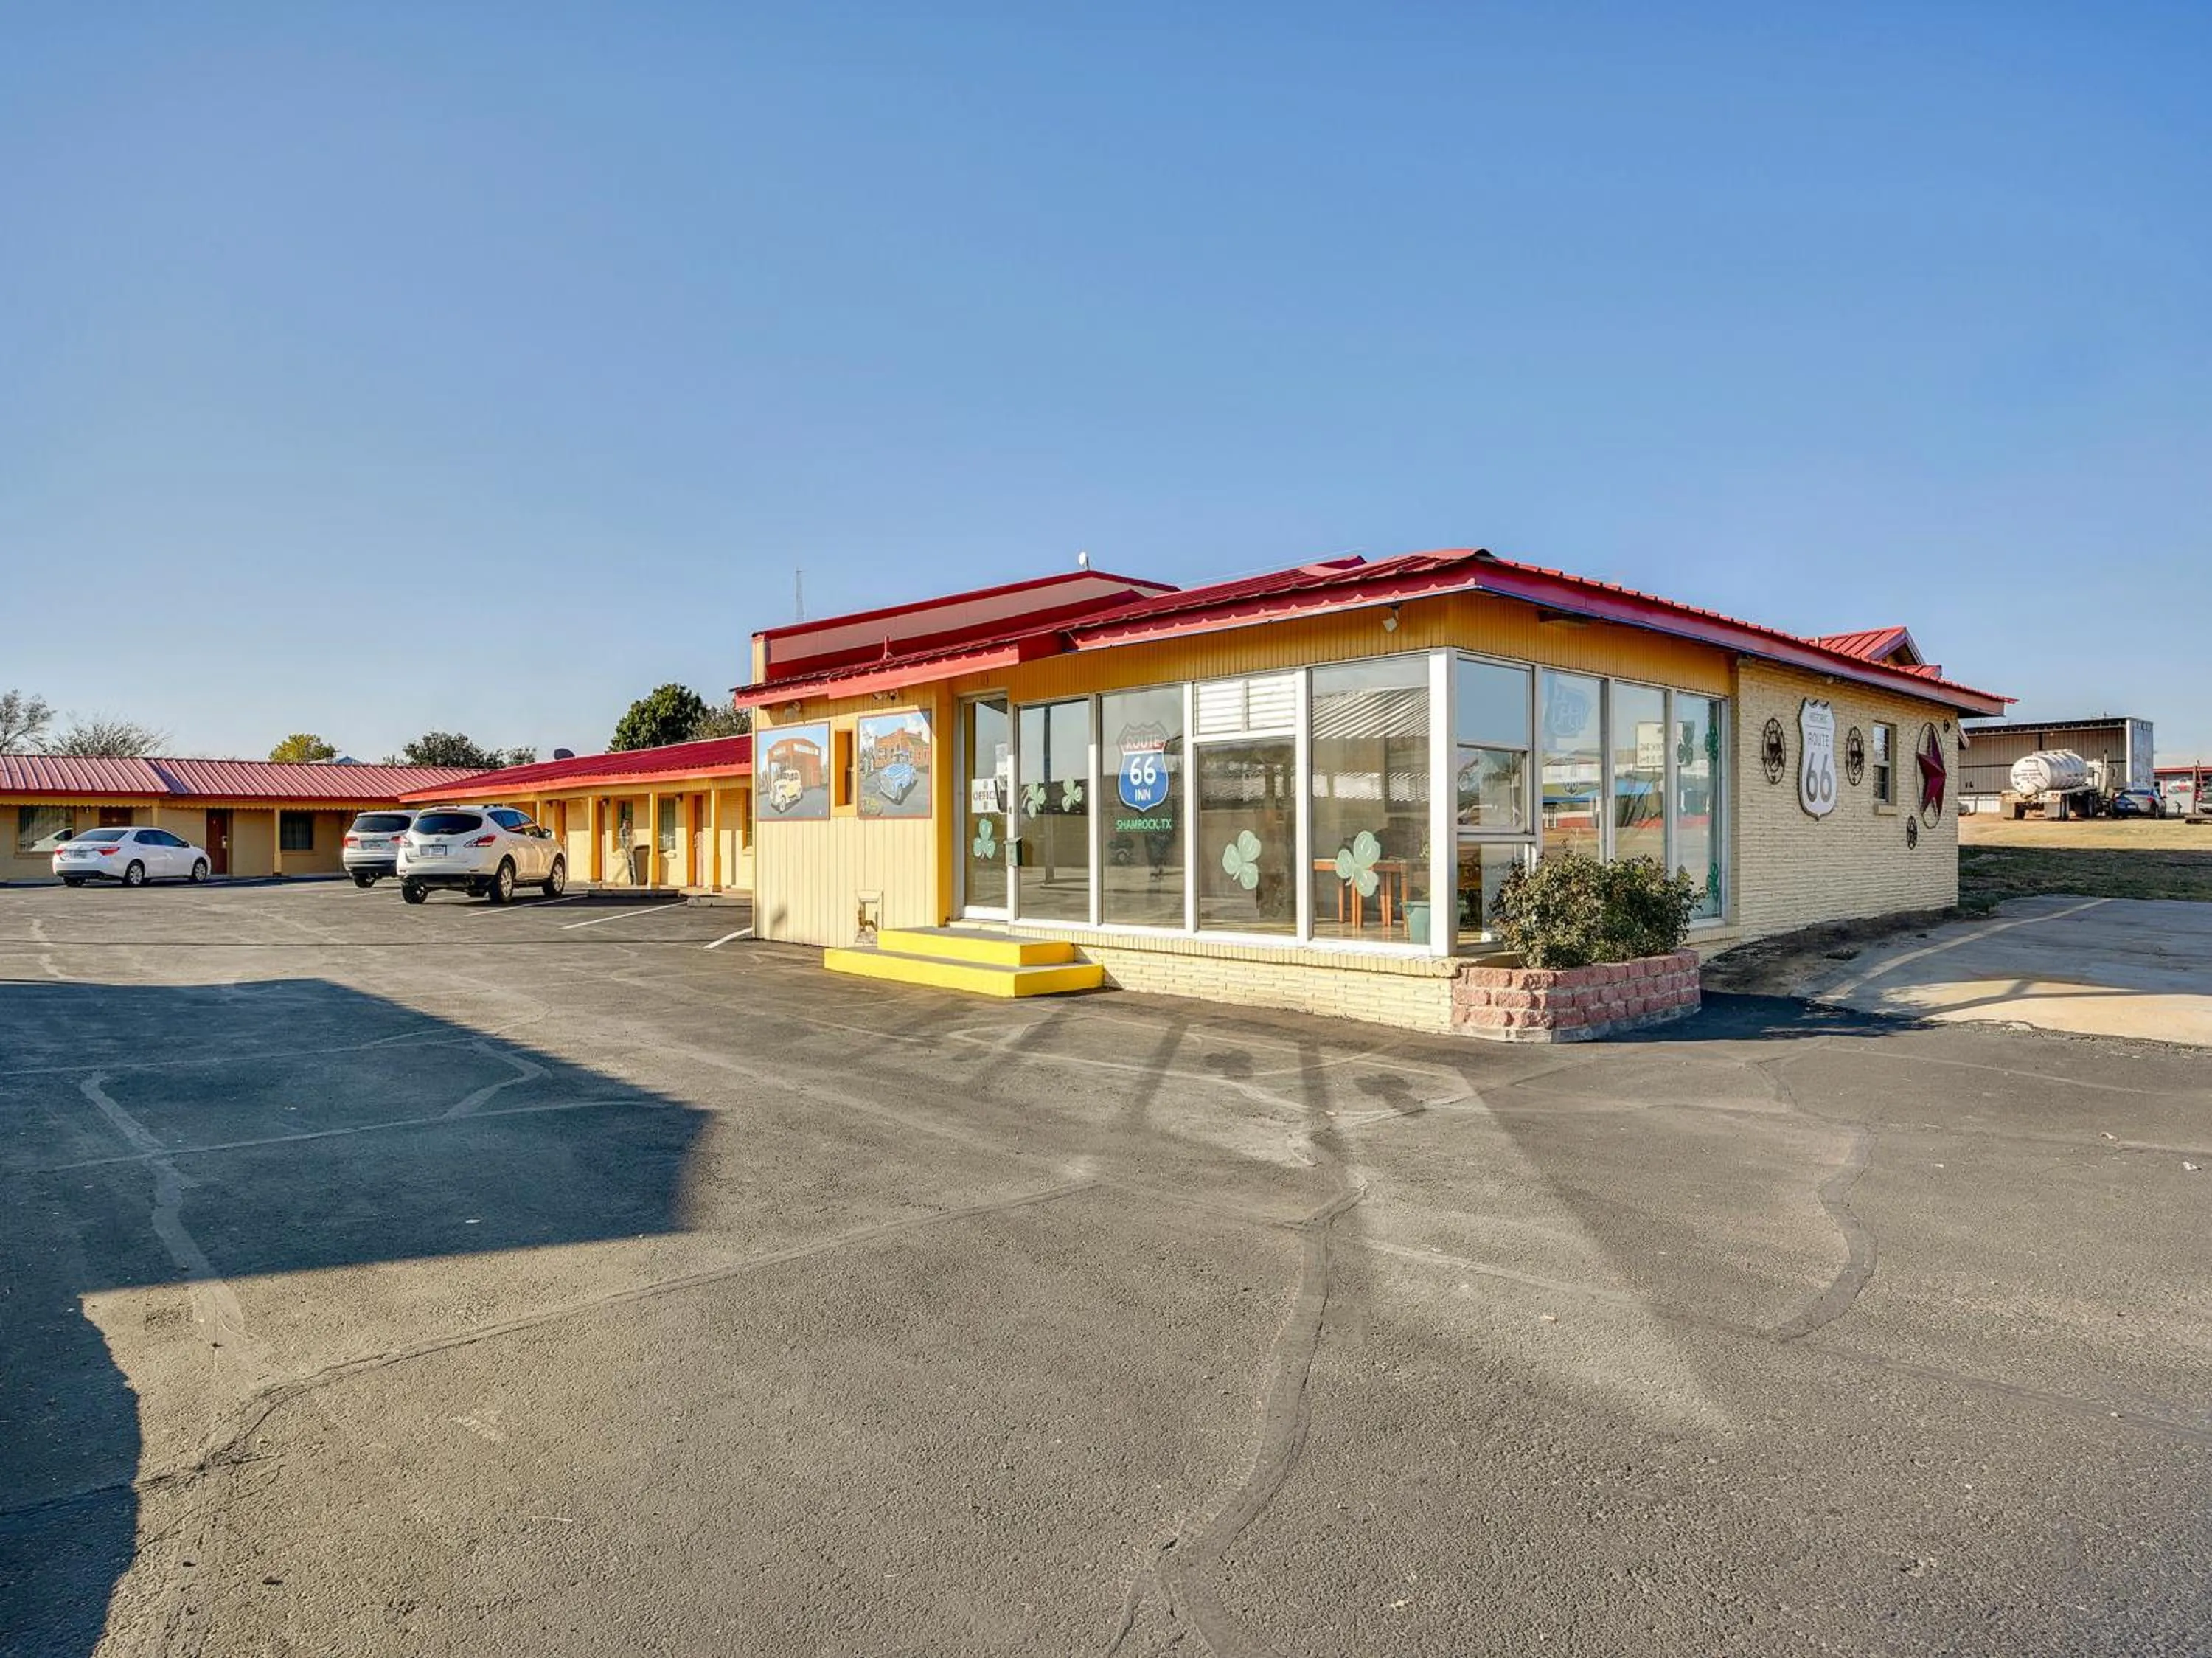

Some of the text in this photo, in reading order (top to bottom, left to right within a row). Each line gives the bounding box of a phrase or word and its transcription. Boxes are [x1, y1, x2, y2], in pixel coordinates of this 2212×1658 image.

[1126, 735, 1161, 749] ROUTE
[1808, 732, 1829, 746] ROUTE
[1130, 756, 1156, 785] 66
[1806, 752, 1832, 802] 66
[973, 791, 998, 800] OFFIC
[1135, 788, 1151, 801] INN
[1161, 818, 1172, 829] TX
